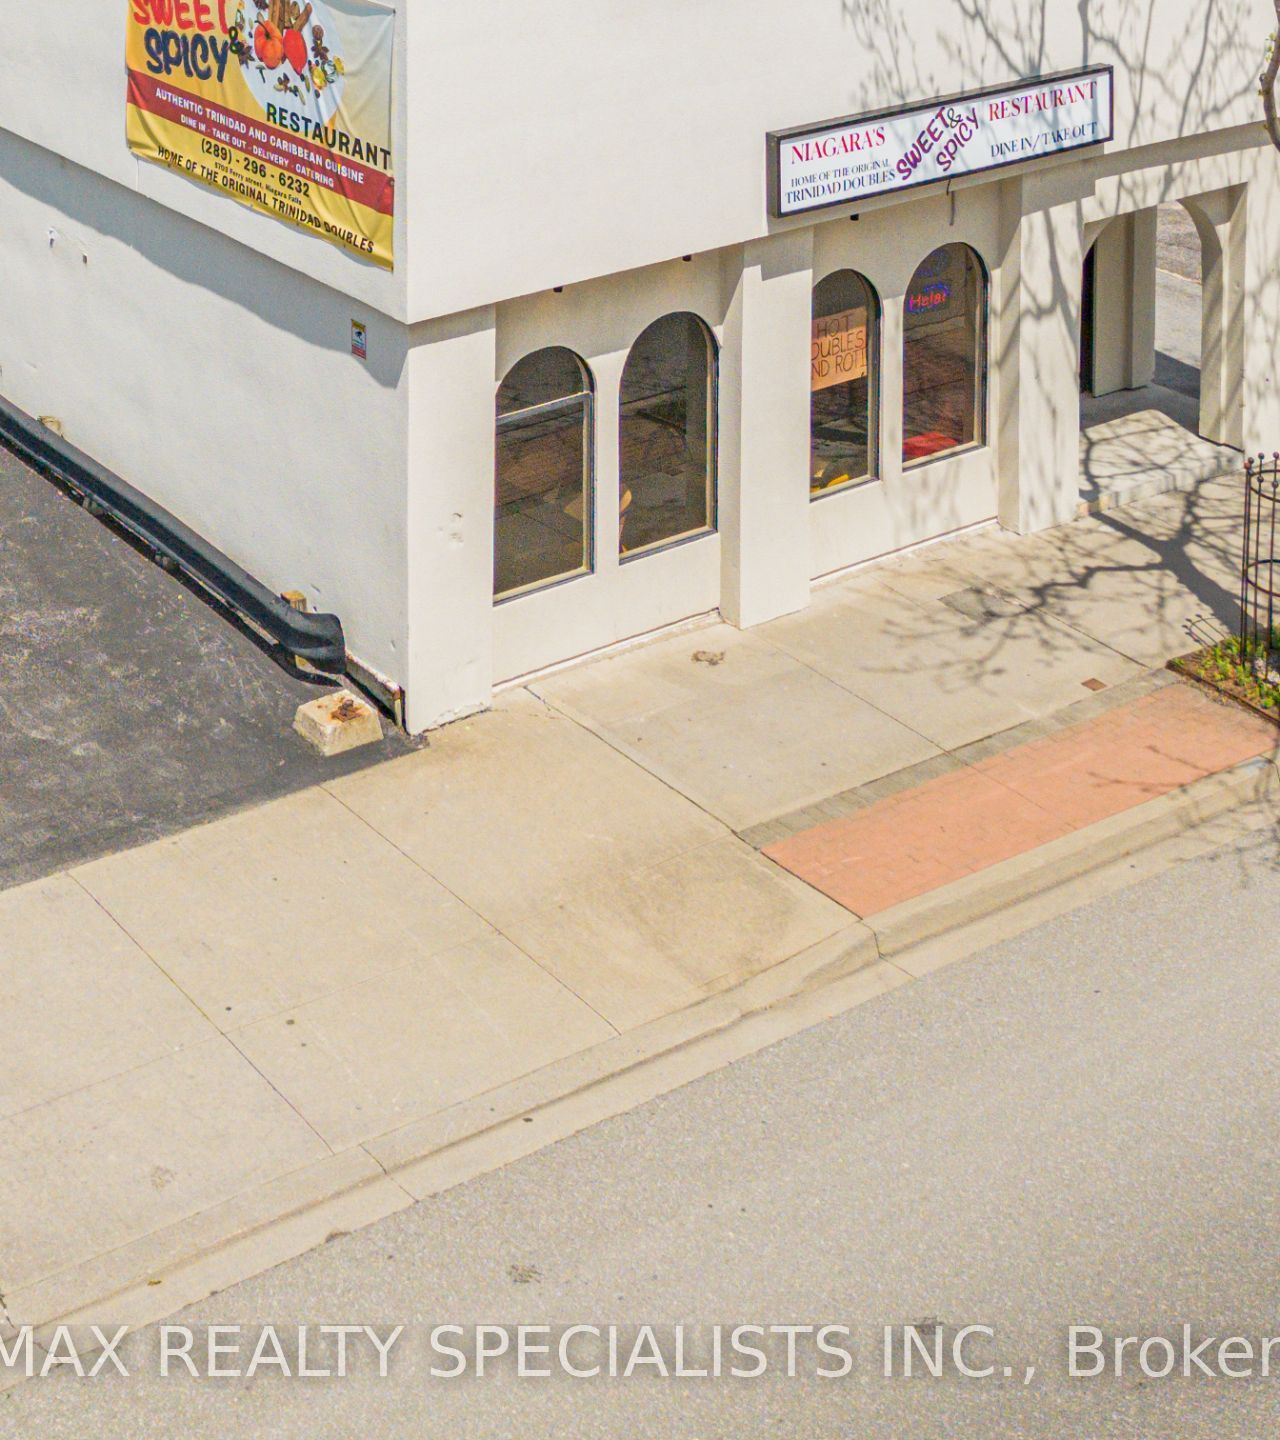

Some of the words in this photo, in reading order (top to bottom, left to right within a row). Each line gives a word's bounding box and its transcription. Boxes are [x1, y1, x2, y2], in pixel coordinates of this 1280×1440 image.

[144, 27, 230, 83] SPICY
[228, 26, 244, 54] &
[947, 108, 964, 129] &
[989, 81, 1098, 122] RESTAURANT
[155, 88, 203, 116] AUTHENTIC
[205, 108, 247, 134] TRINIDAD
[248, 126, 268, 143] AND
[269, 134, 323, 167] CARIBBEAN
[324, 158, 365, 184] CUISINE
[180, 114, 197, 128] DINE
[198, 122, 207, 133] IN
[212, 127, 231, 143] TAKE
[231, 136, 247, 149] OUT
[252, 145, 289, 168] DELIVERY
[295, 163, 335, 189] CATERING
[266, 102, 392, 171] RESTAURANT
[791, 126, 886, 164] NIAGARA'S
[896, 106, 950, 180] SWEET
[935, 107, 979, 172] SPICY
[991, 139, 1018, 158] DINE
[1072, 121, 1098, 139] OUT
[201, 138, 233, 165] (289)
[243, 157, 267, 178] 296
[278, 172, 310, 198] 6232
[785, 181, 841, 204] TRINIDAD
[843, 168, 896, 192] DOUBLES
[791, 173, 817, 188] HOME
[818, 170, 830, 181] OF
[833, 167, 850, 178] THE
[851, 158, 890, 175] ORIGINAL
[158, 145, 184, 167] HOME
[185, 159, 198, 172] OF
[200, 164, 219, 183] THE
[221, 175, 269, 205] ORIGINAL
[272, 197, 322, 229] TRINIDAD
[323, 220, 375, 254] DOUBLES
[816, 313, 852, 339] HOT
[834, 348, 867, 375] ROTI
